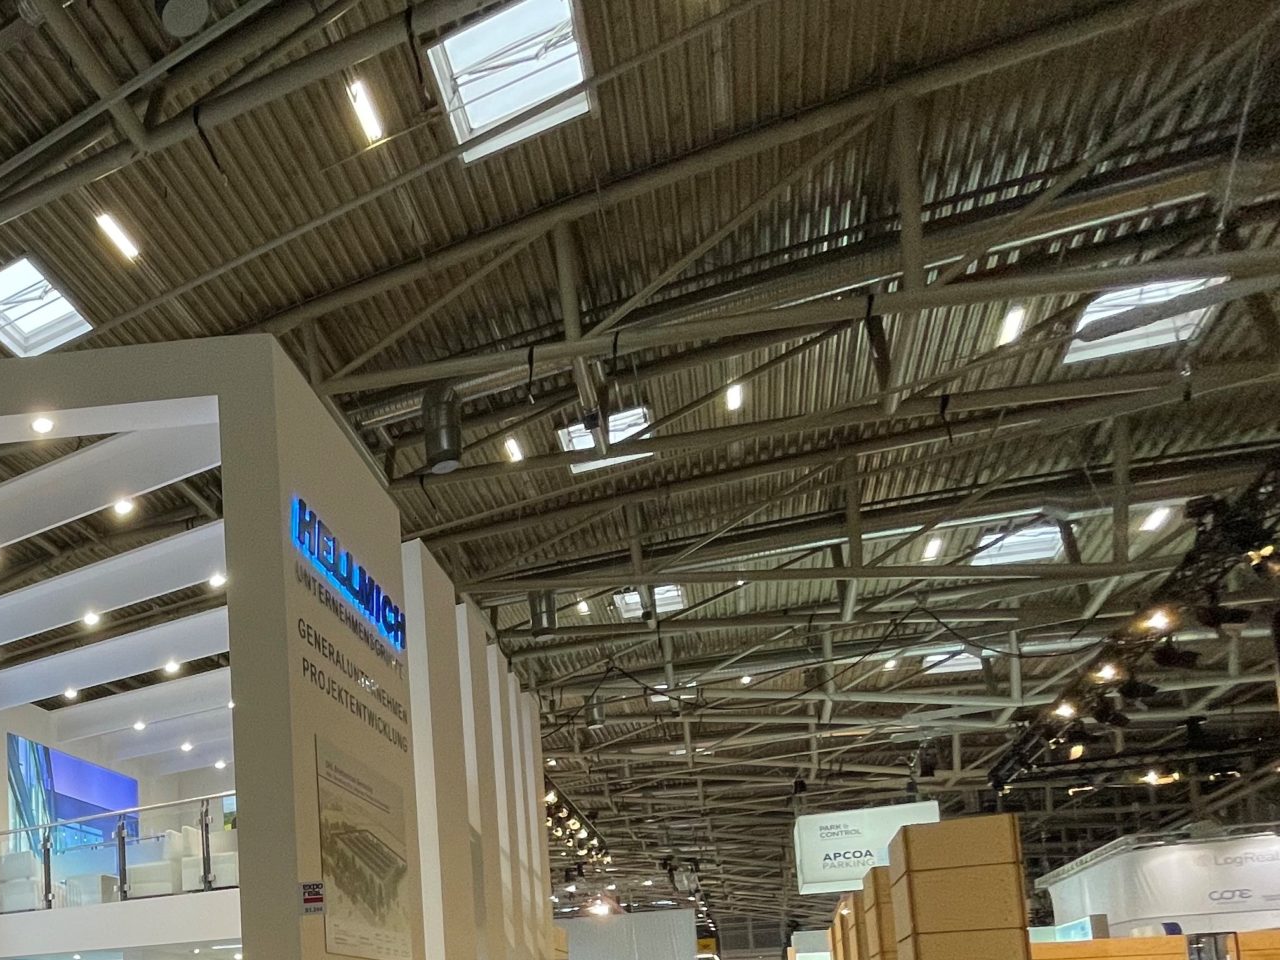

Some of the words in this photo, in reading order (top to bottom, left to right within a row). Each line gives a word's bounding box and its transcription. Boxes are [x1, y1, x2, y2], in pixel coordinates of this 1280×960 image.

[296, 497, 406, 650] HELLMICH
[302, 657, 408, 753] PROJEKTENTWICKLUNG
[819, 824, 841, 832] PARK
[819, 829, 862, 838] CONTROL
[823, 849, 874, 861] APCOA
[822, 859, 876, 870] PARKING
